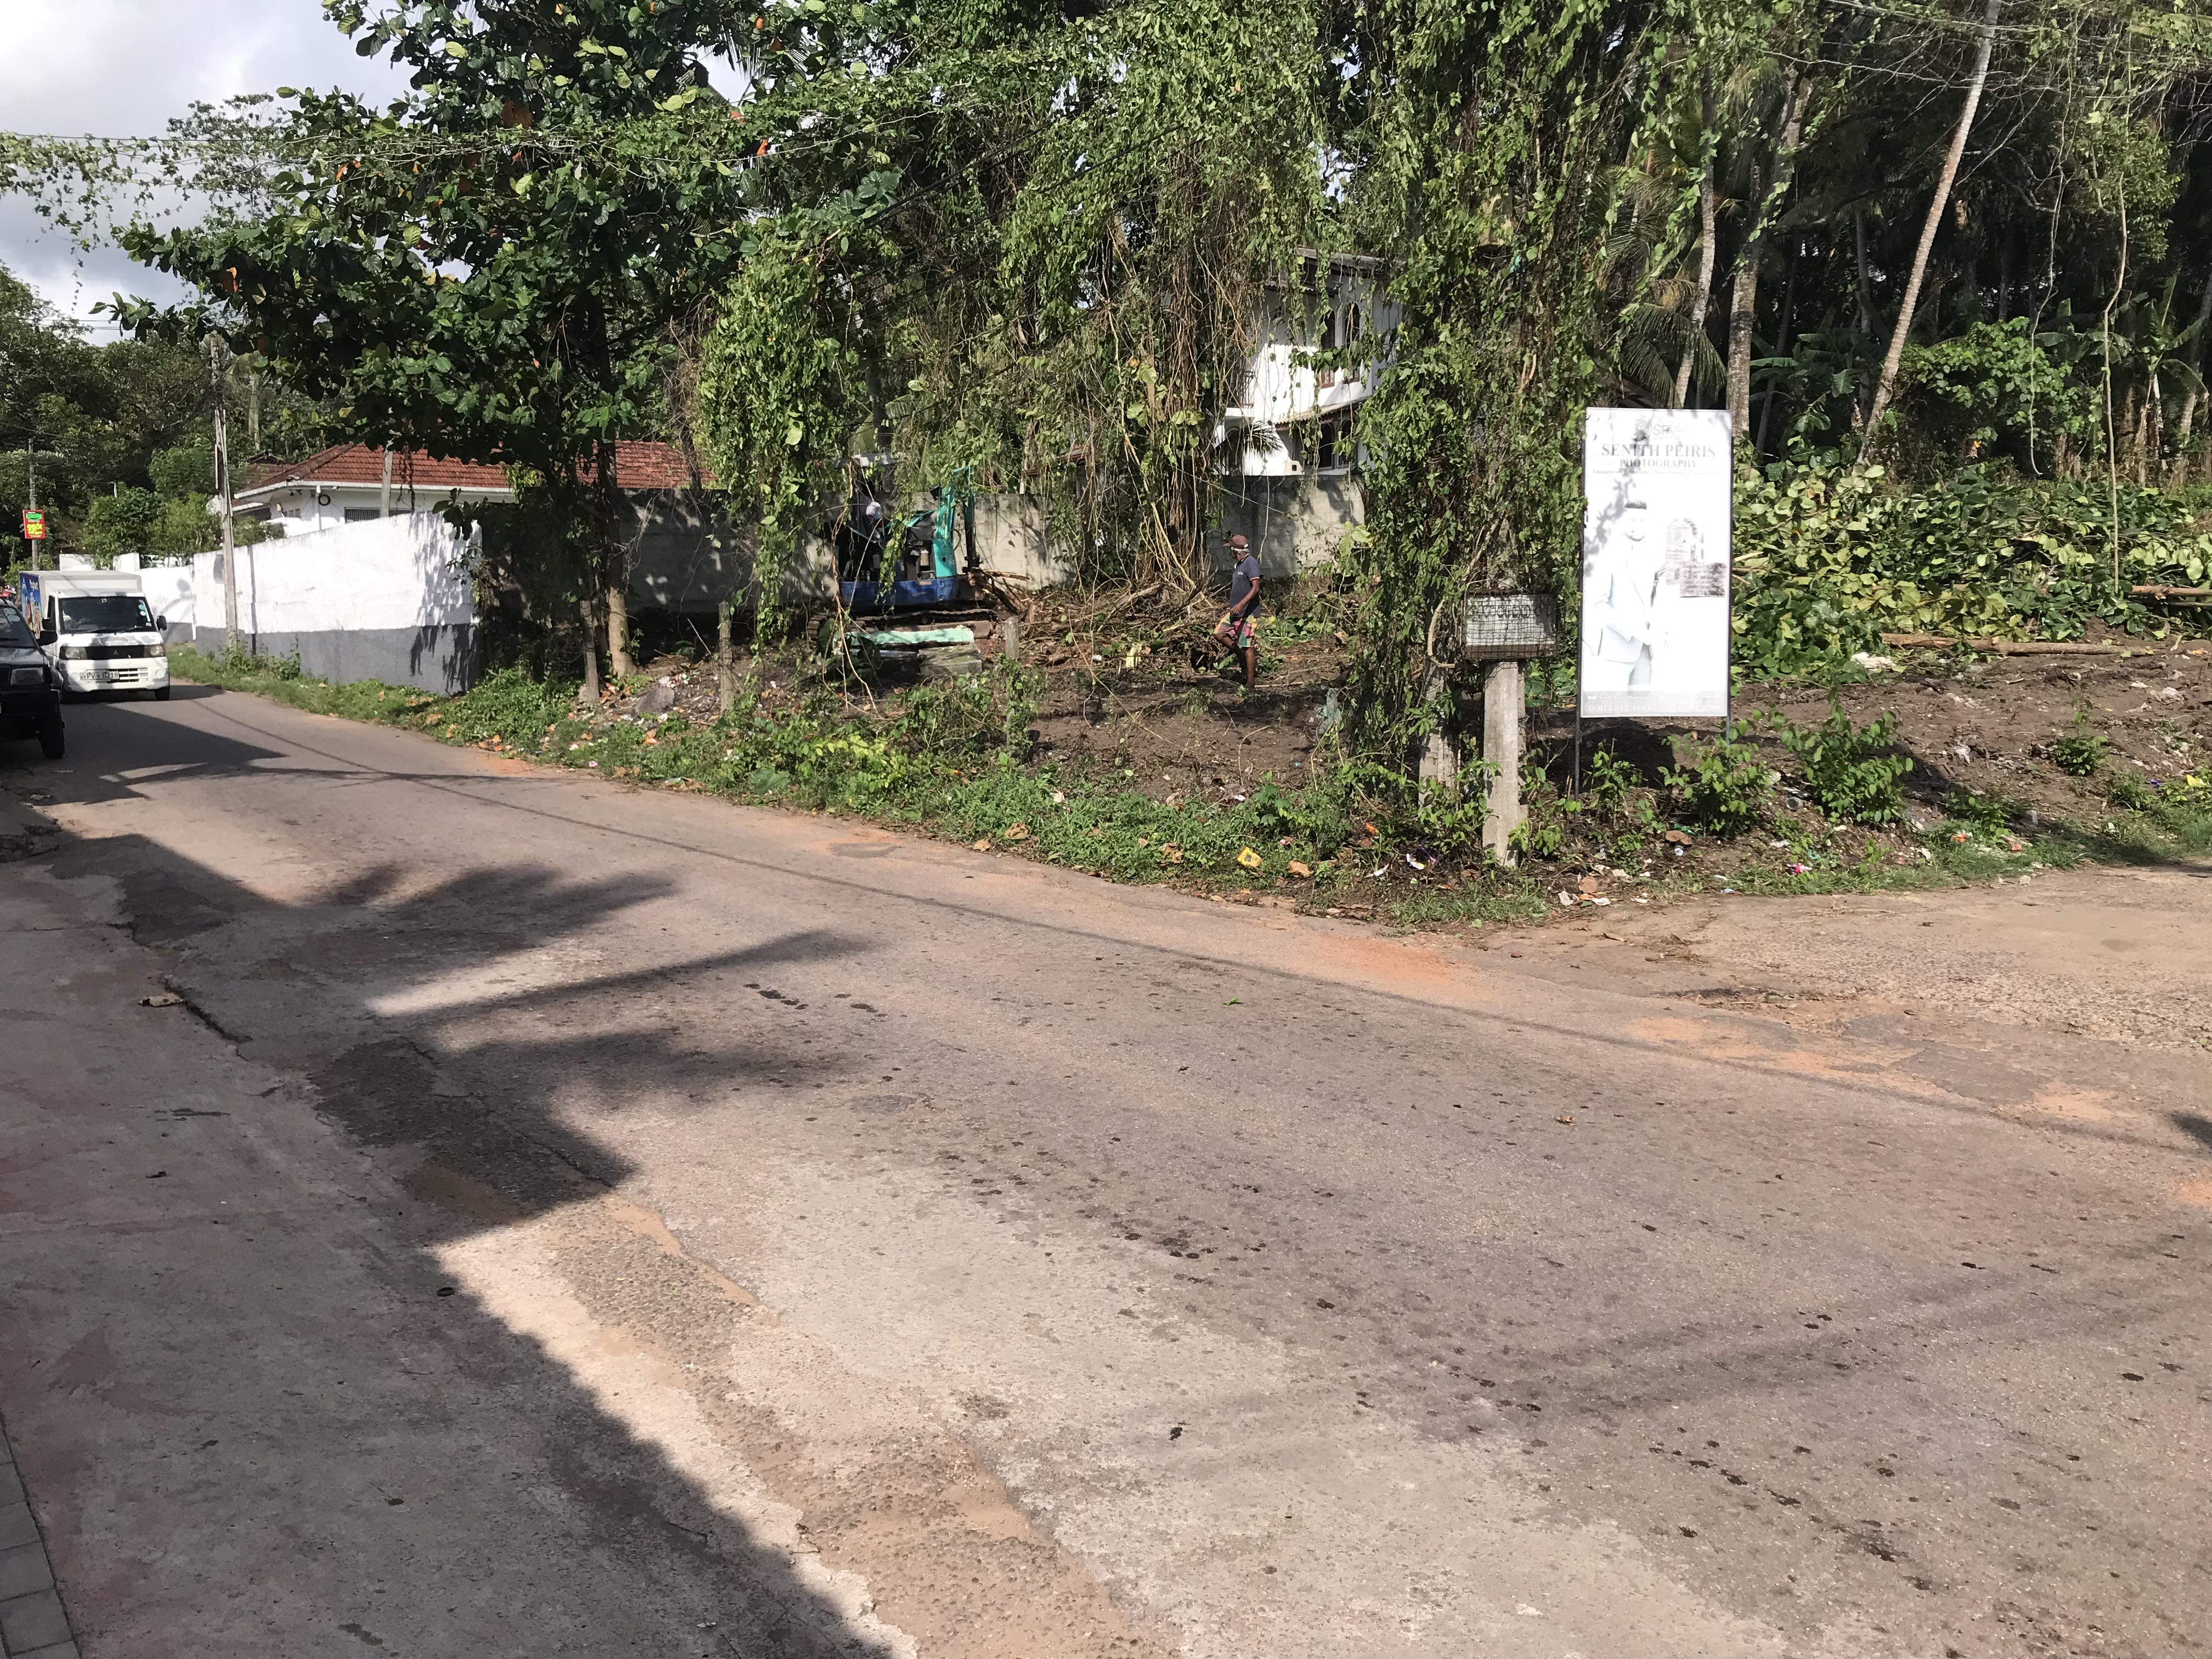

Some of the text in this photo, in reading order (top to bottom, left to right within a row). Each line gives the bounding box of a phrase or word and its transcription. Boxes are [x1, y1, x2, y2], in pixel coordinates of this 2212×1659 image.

[1601, 443, 1716, 458] SENITH PEIRIS
[1620, 458, 1696, 468] PHOTOGRAPHY
